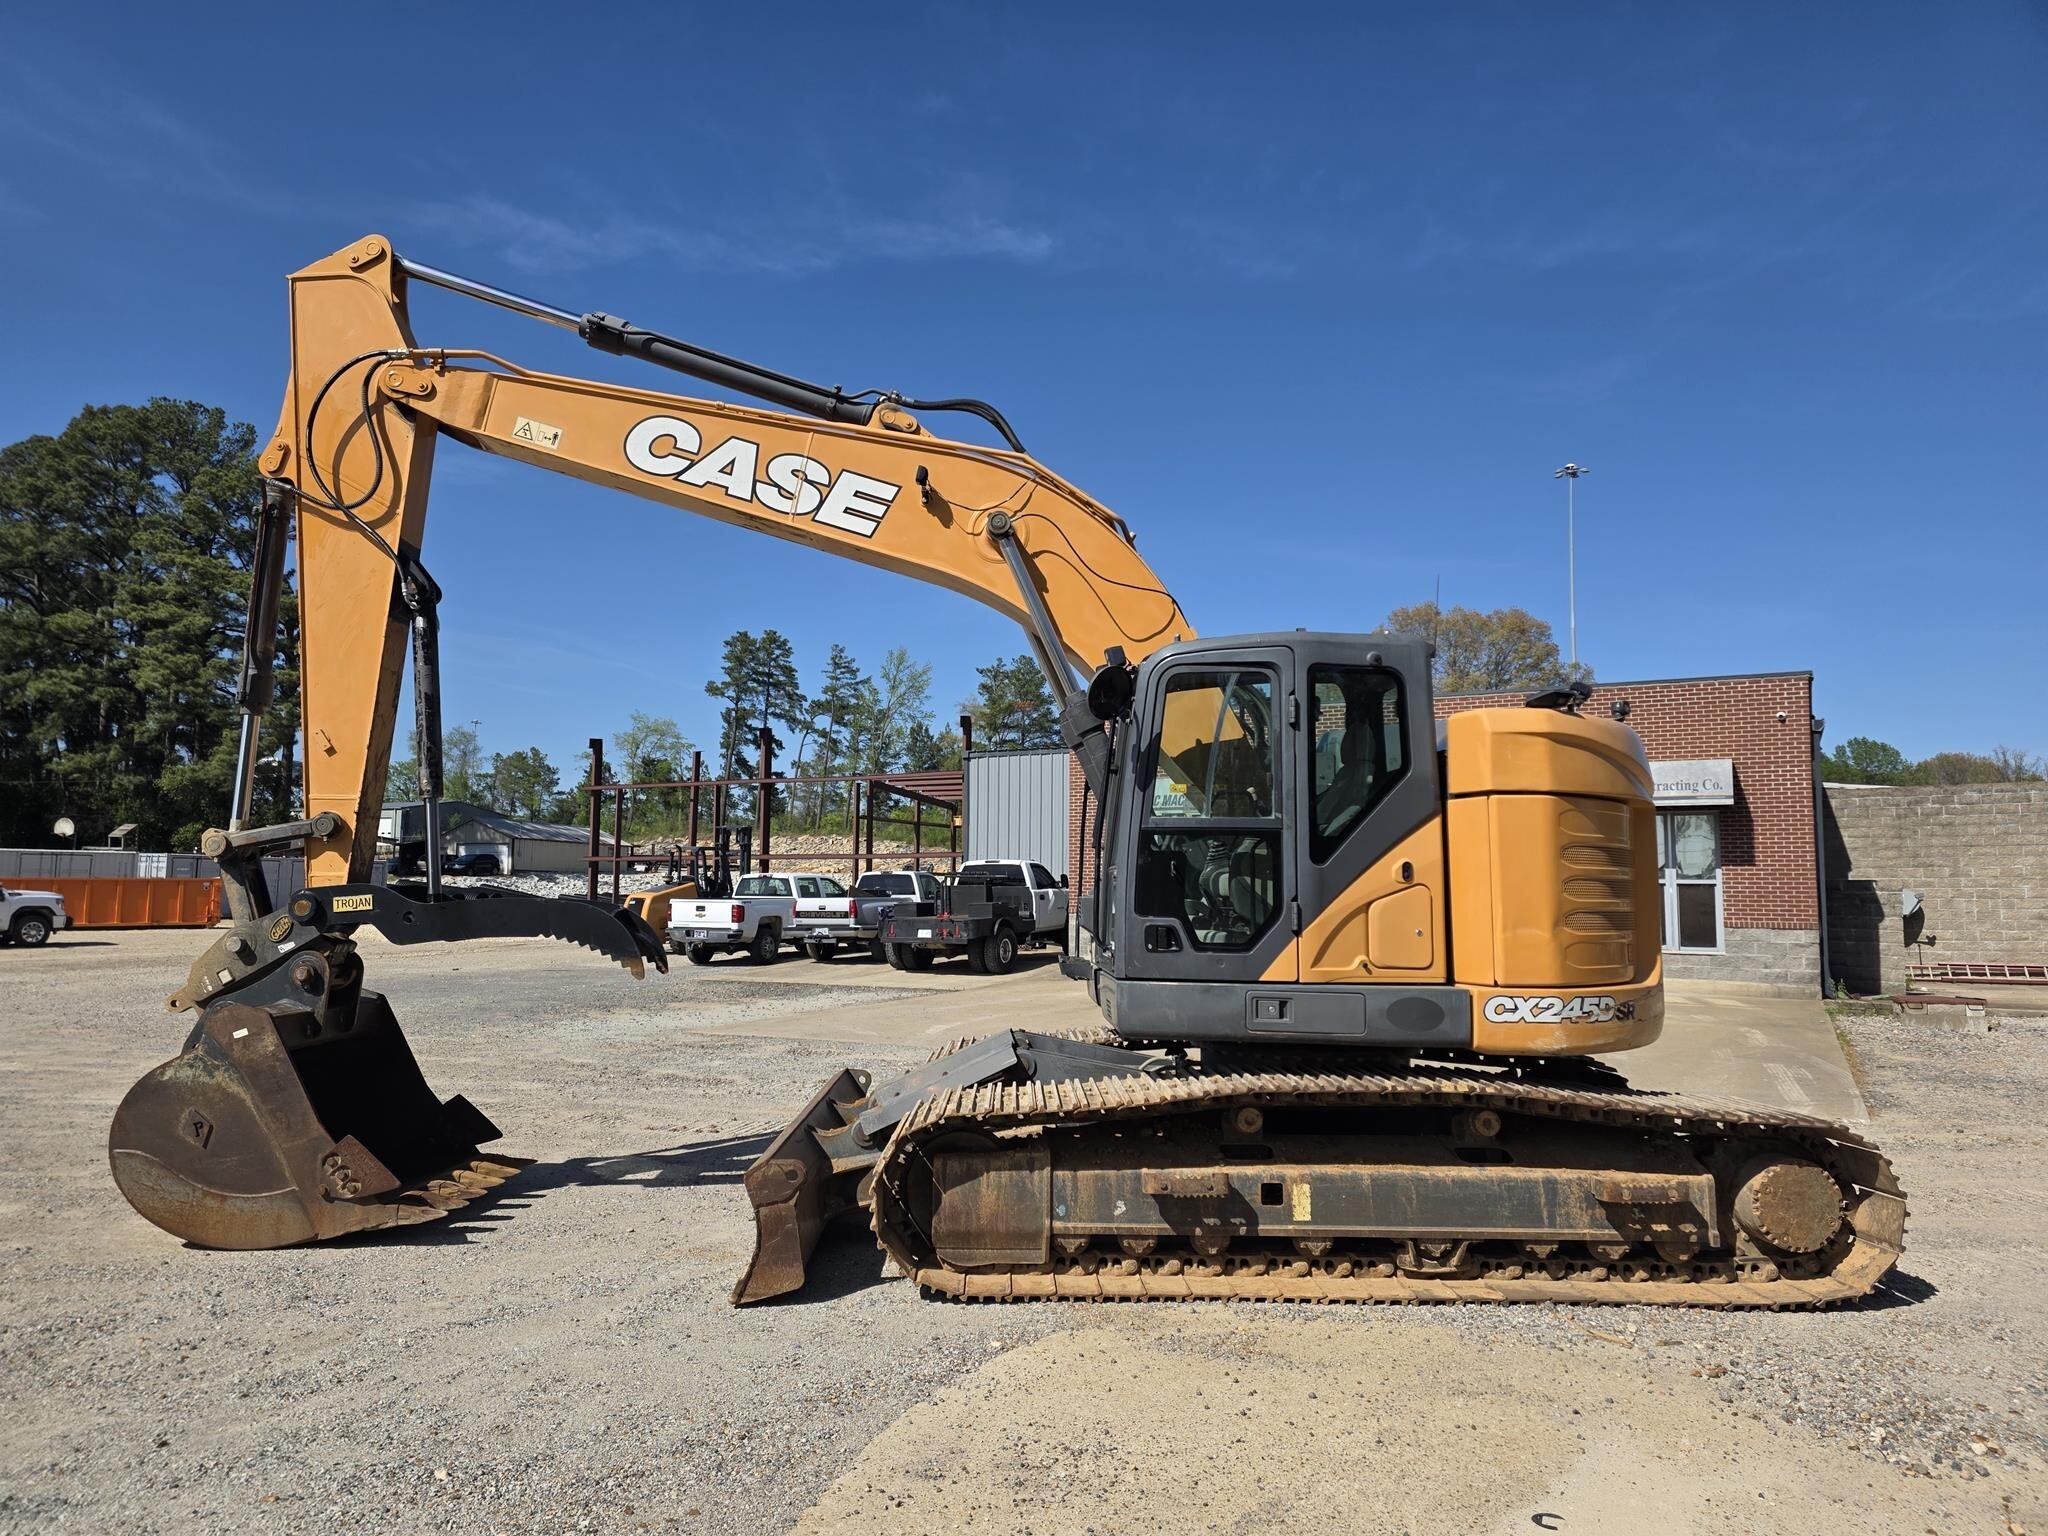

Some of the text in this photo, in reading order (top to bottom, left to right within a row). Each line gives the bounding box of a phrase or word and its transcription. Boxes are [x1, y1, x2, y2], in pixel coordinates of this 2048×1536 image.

[624, 415, 902, 538] CASE
[1654, 778, 1723, 793] racting Co.
[334, 897, 372, 910] TROJAN
